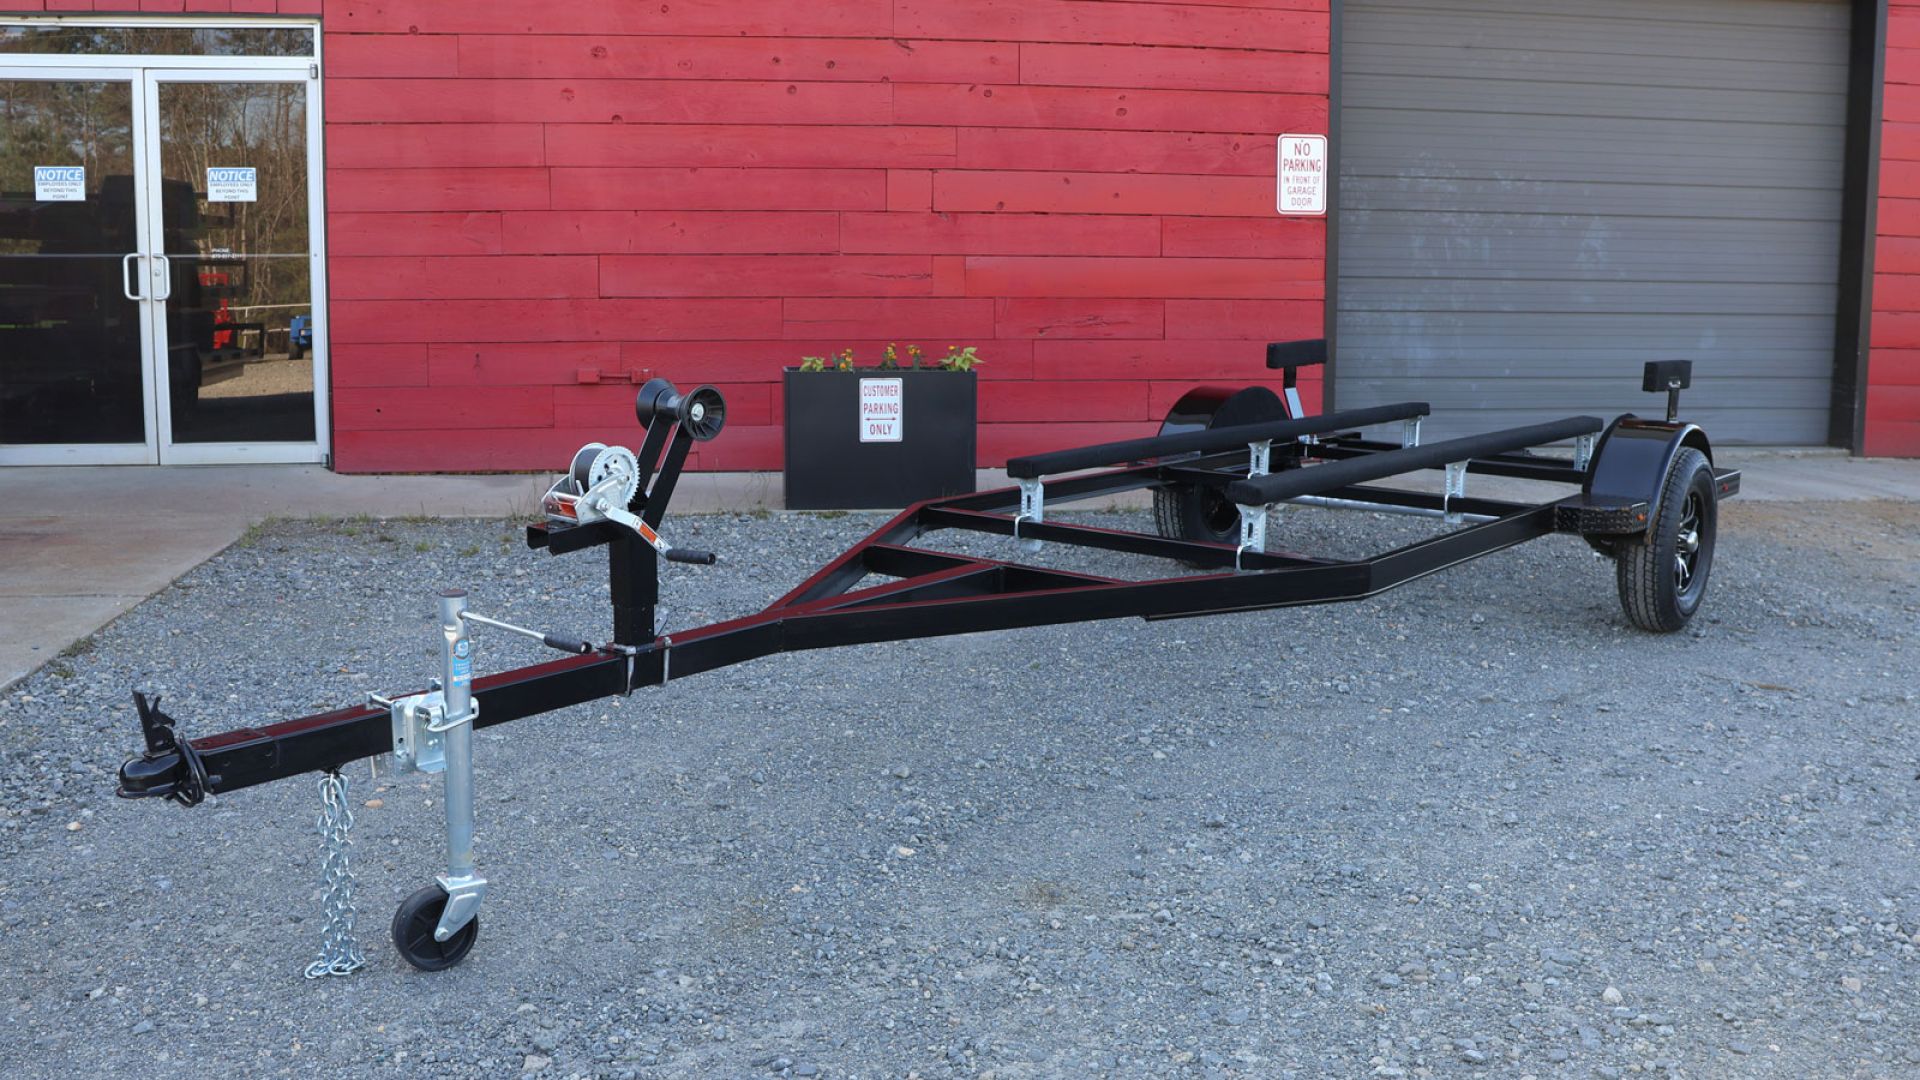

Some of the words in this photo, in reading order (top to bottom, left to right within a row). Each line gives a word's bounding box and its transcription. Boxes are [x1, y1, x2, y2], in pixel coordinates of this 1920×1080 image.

[1294, 143, 1311, 156] NO
[1283, 159, 1321, 172] PARKING
[37, 169, 83, 180] NOTICE
[210, 170, 254, 181] NOTICE
[1283, 176, 1290, 184] IN
[1292, 176, 1310, 184] FRONT
[1313, 176, 1320, 184] OF
[1287, 186, 1317, 195] GARAGE
[1291, 197, 1312, 206] DOOR
[864, 385, 898, 396] CUSTOMER
[864, 403, 898, 414] PARKING
[870, 424, 892, 435] ONLY
